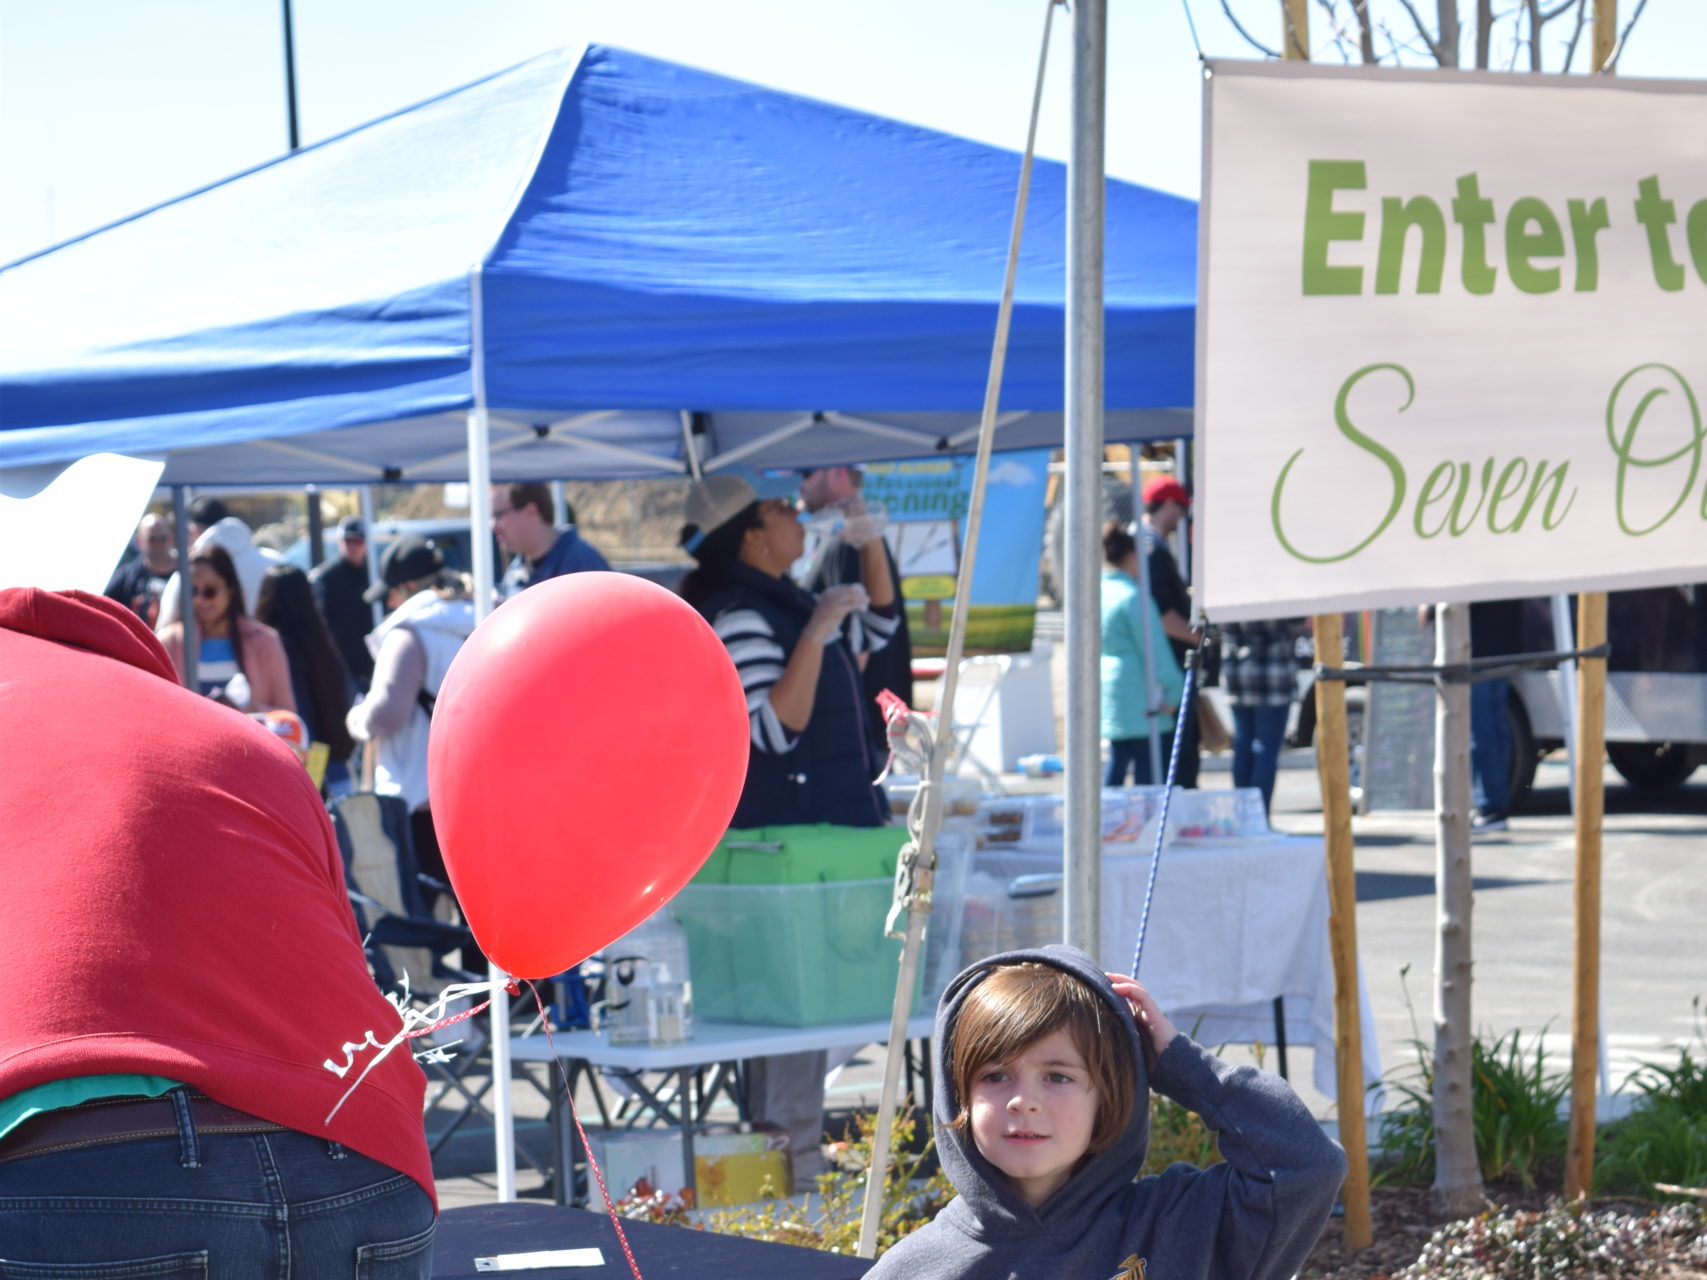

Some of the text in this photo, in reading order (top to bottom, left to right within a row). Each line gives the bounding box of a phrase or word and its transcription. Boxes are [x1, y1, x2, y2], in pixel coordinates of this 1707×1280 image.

[1302, 159, 1610, 296] Enter
[1270, 362, 1707, 564] Seven O
